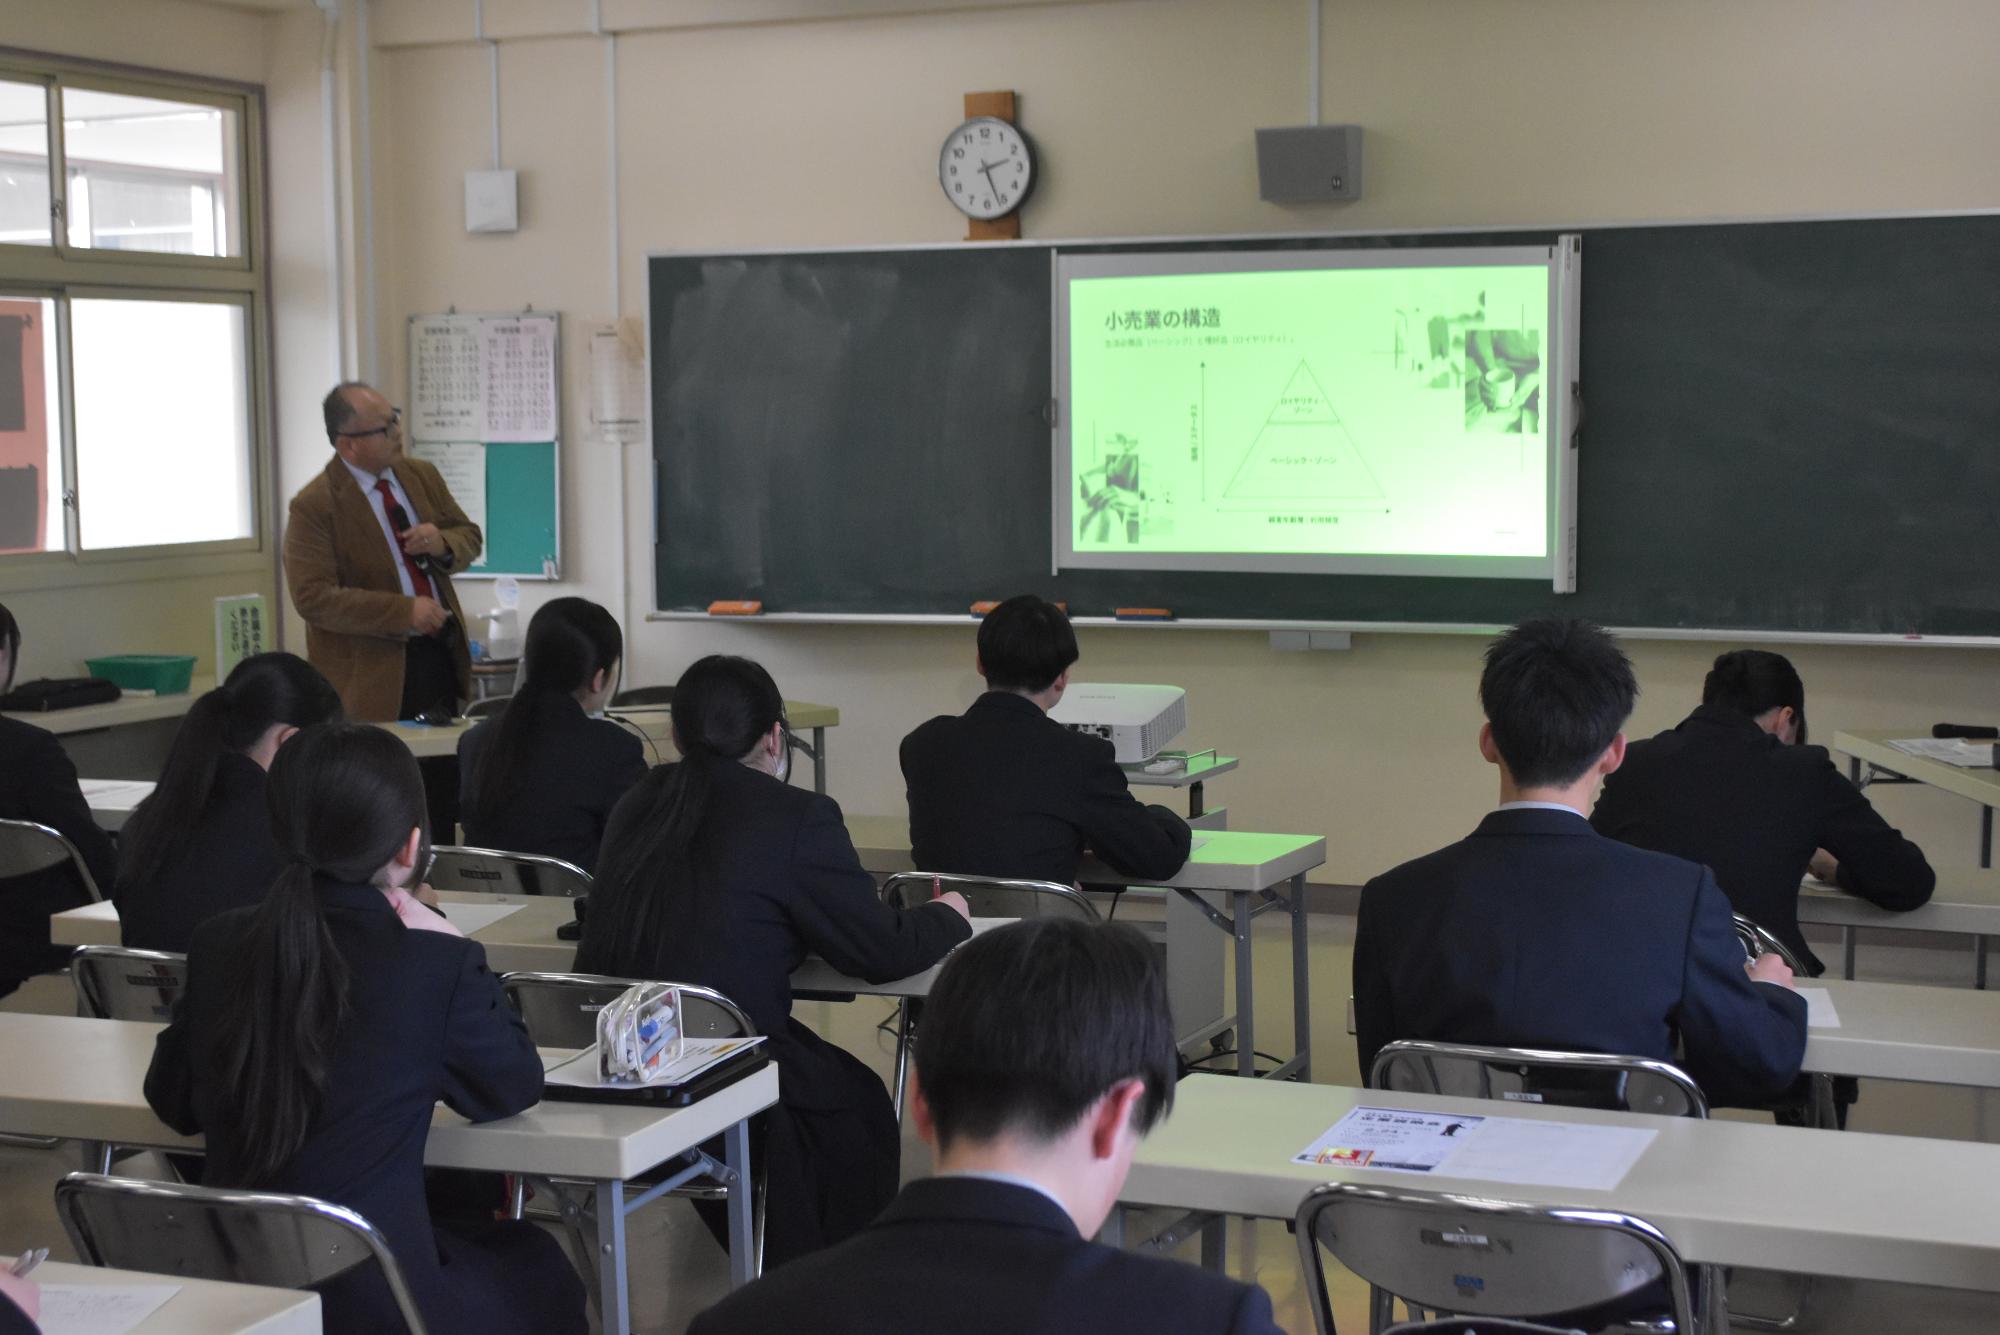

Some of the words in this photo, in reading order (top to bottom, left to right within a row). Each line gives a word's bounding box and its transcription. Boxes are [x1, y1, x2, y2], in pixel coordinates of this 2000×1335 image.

[964, 133, 973, 144] 11
[980, 127, 990, 138] 12
[953, 147, 965, 160] 10
[1011, 143, 1018, 155] 2
[949, 165, 957, 176] 9
[1016, 160, 1023, 173] 3
[955, 182, 962, 194] 8
[1011, 180, 1018, 190] 4
[968, 194, 975, 206] 7
[983, 198, 991, 209] 6
[1001, 193, 1008, 205] 5
[1105, 308, 1221, 331] 小売業の構造
